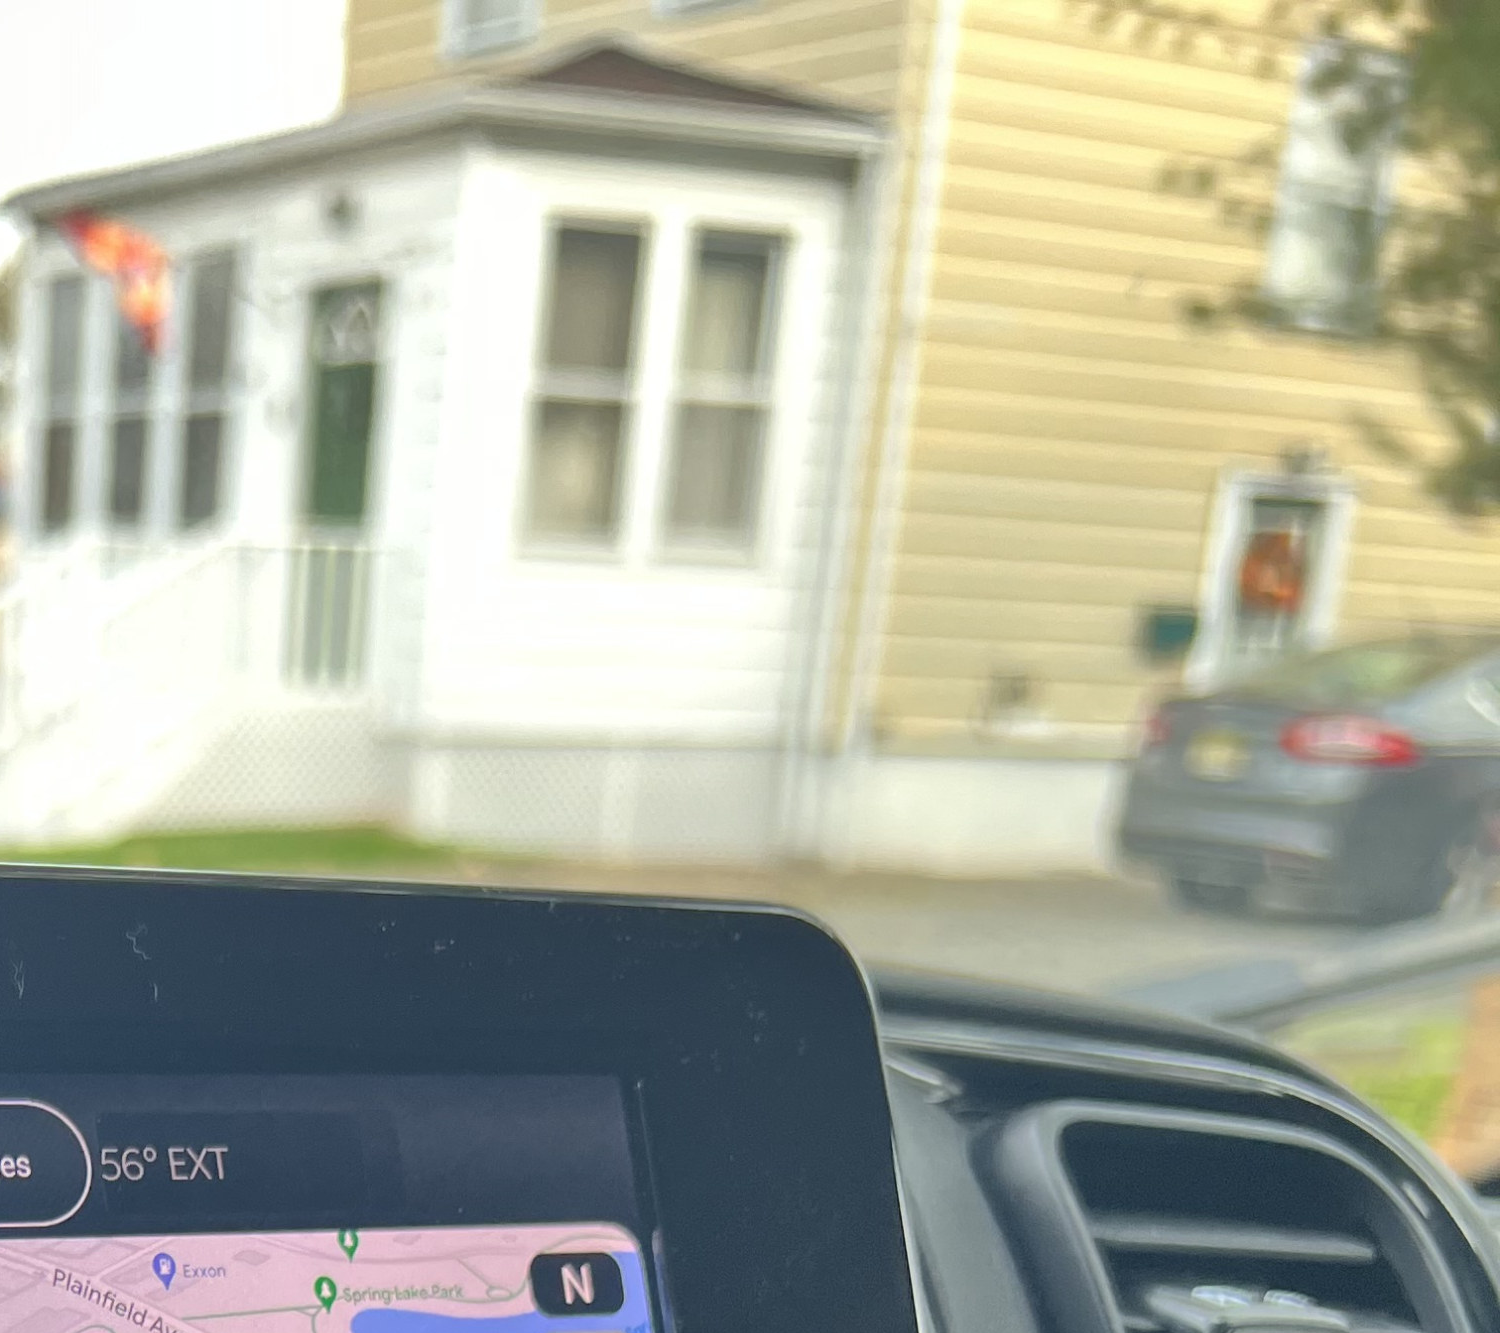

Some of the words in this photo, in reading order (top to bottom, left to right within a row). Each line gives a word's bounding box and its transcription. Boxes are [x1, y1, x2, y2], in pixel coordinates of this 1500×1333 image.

[168, 1146, 229, 1180] EXT
[182, 1263, 227, 1279] Exxon
[560, 1262, 596, 1306] N
[51, 1267, 148, 1327] Plainfield
[342, 1286, 392, 1305] Spring
[432, 1282, 464, 1299] Park
